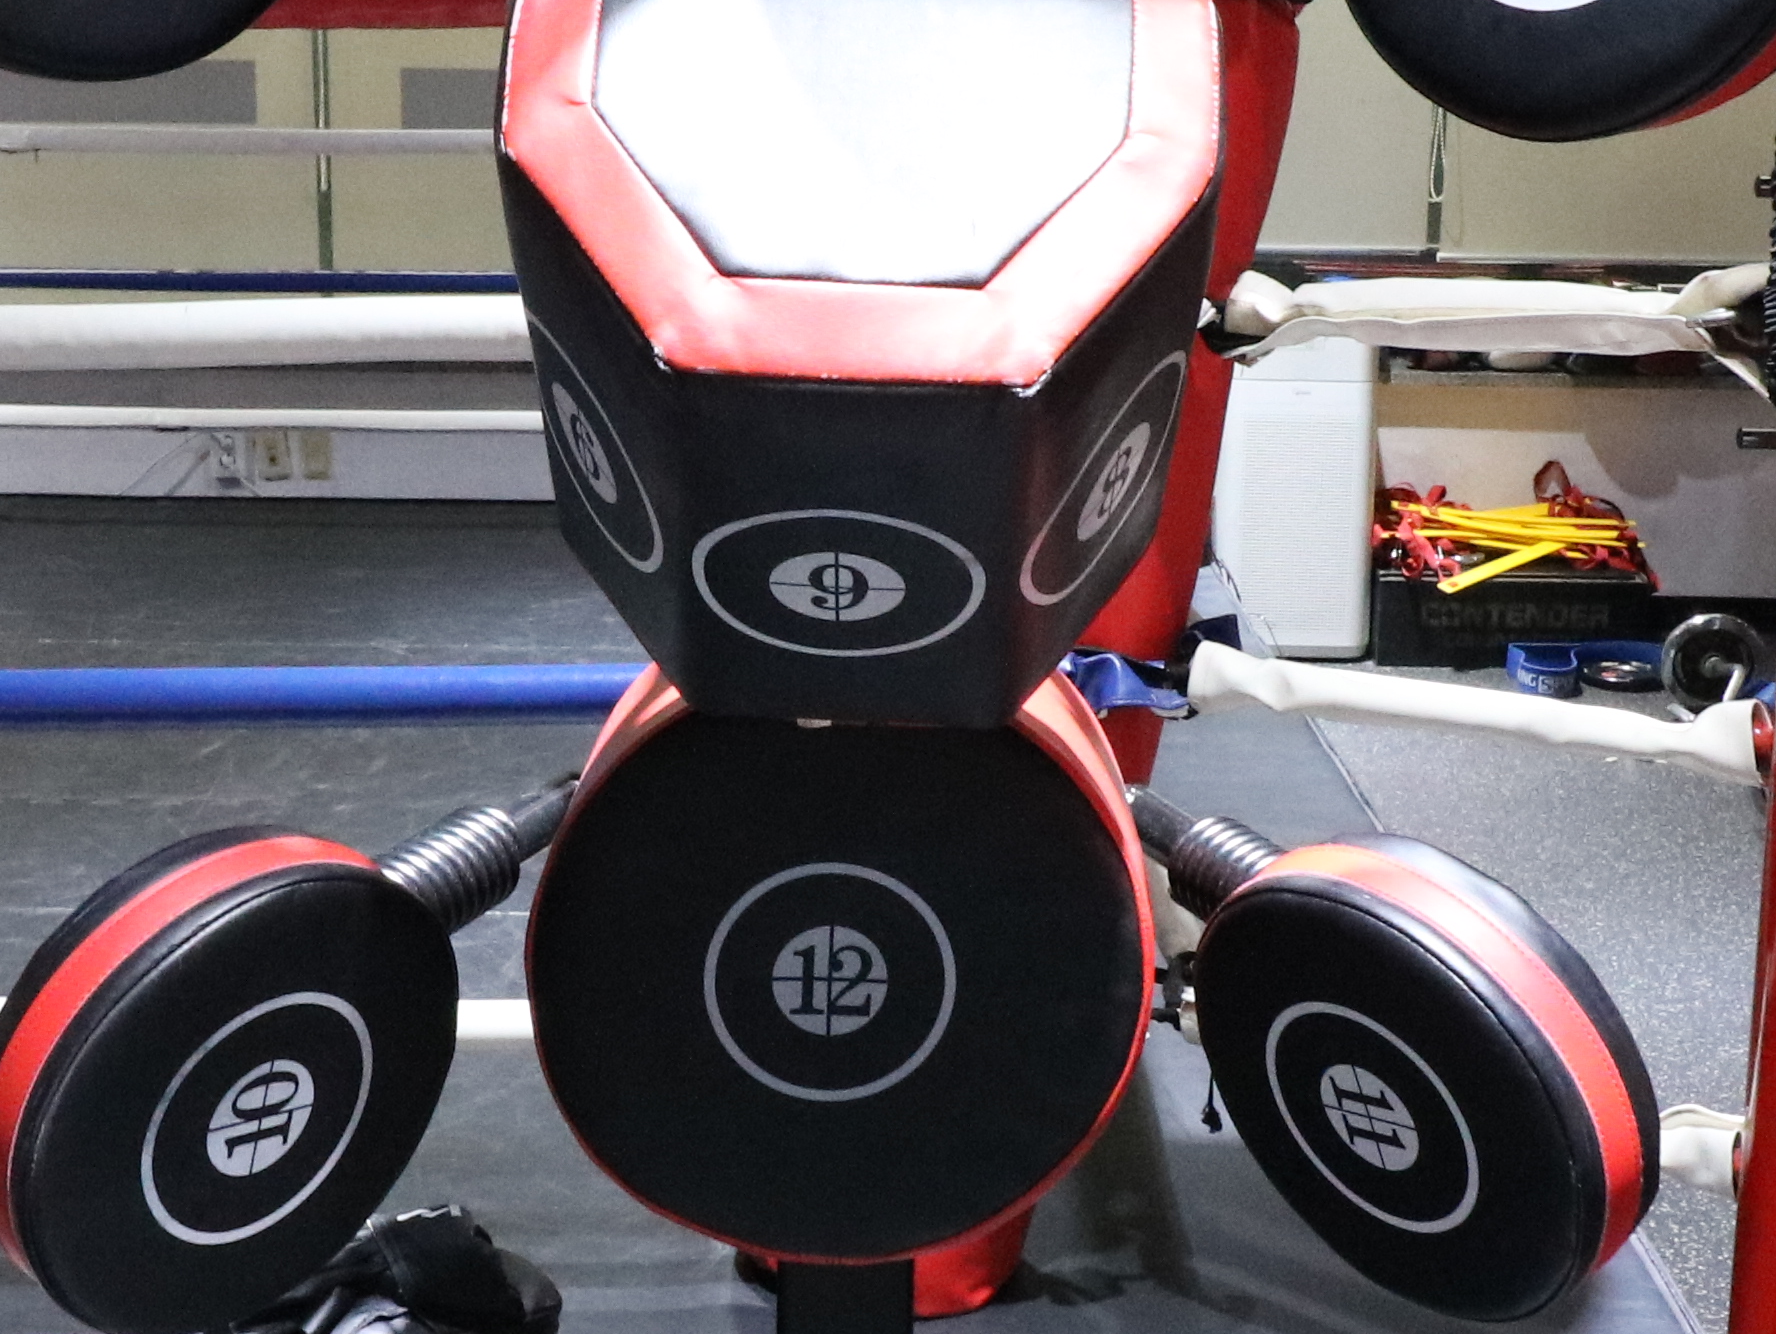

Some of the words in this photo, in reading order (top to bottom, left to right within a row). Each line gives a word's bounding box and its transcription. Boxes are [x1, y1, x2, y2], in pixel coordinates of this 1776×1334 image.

[808, 563, 867, 611] 9
[788, 943, 872, 1017] 12
[227, 1070, 300, 1160] 10
[1331, 1075, 1407, 1151] 11
